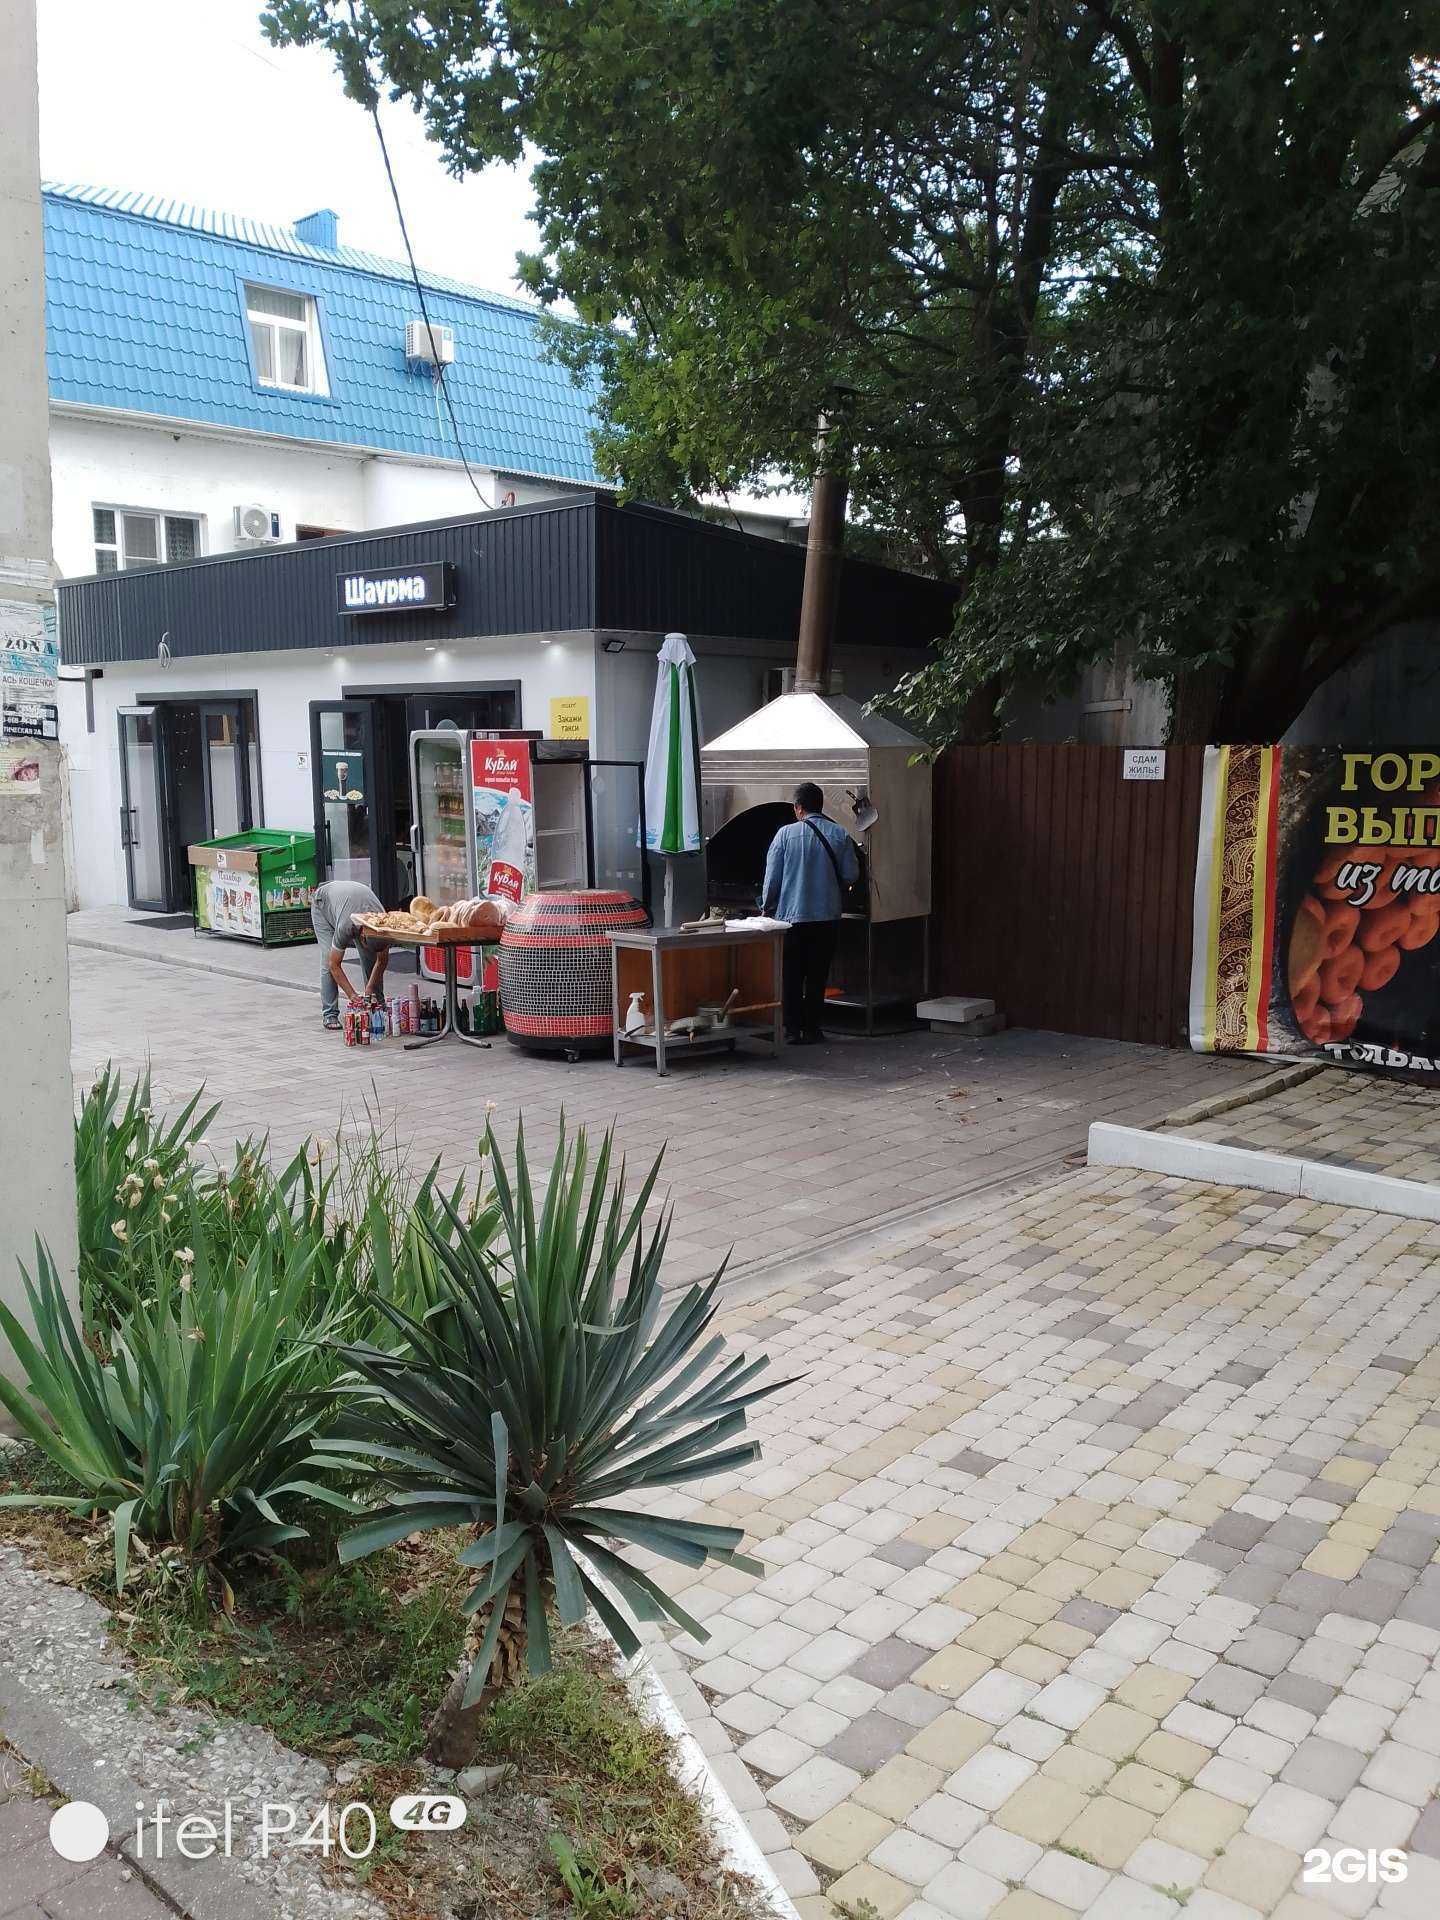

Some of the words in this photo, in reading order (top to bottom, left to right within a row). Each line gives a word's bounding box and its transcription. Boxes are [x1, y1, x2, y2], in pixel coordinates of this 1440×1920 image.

[345, 576, 425, 606] Шаурма
[557, 714, 582, 723] Закажи
[1128, 766, 1160, 774] ЖИЛЬЕ
[1132, 755, 1158, 764] СДАМ
[1340, 753, 1440, 791] ГОР
[1324, 806, 1440, 845] ВЫП
[1337, 863, 1382, 906] из
